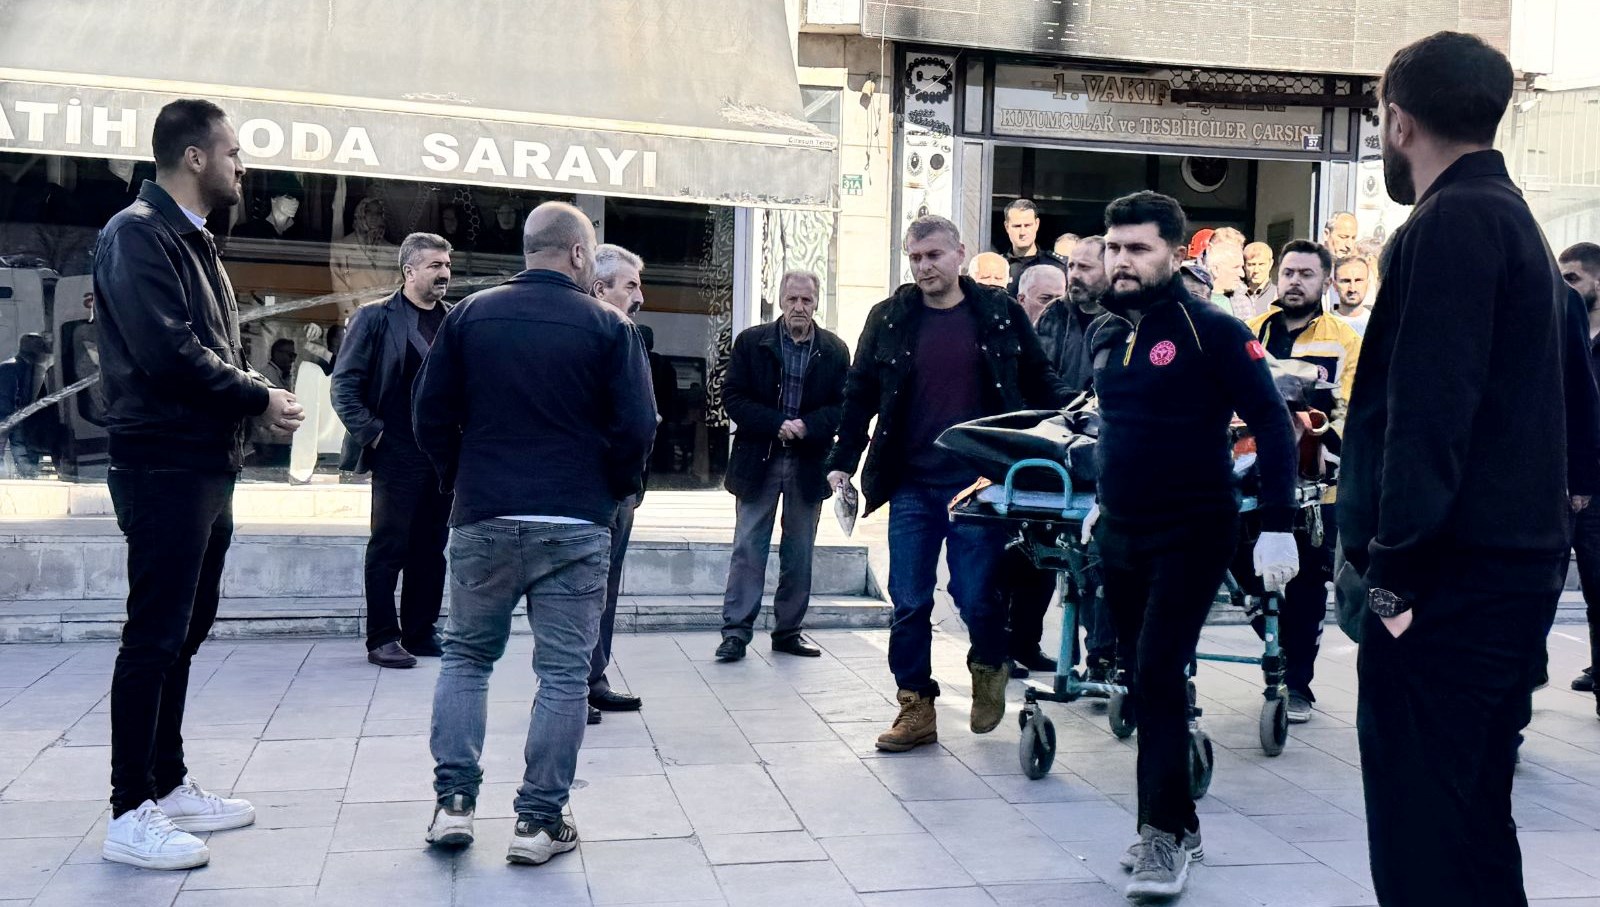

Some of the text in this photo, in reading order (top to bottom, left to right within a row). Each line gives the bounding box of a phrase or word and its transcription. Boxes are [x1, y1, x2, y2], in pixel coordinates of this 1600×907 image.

[1001, 109, 1114, 132] KUYUMCULAR
[1119, 120, 1136, 132] ve
[1308, 139, 1318, 147] 57
[238, 118, 380, 166] ODA
[421, 132, 657, 188] SARAYI
[843, 180, 861, 189] 31A
